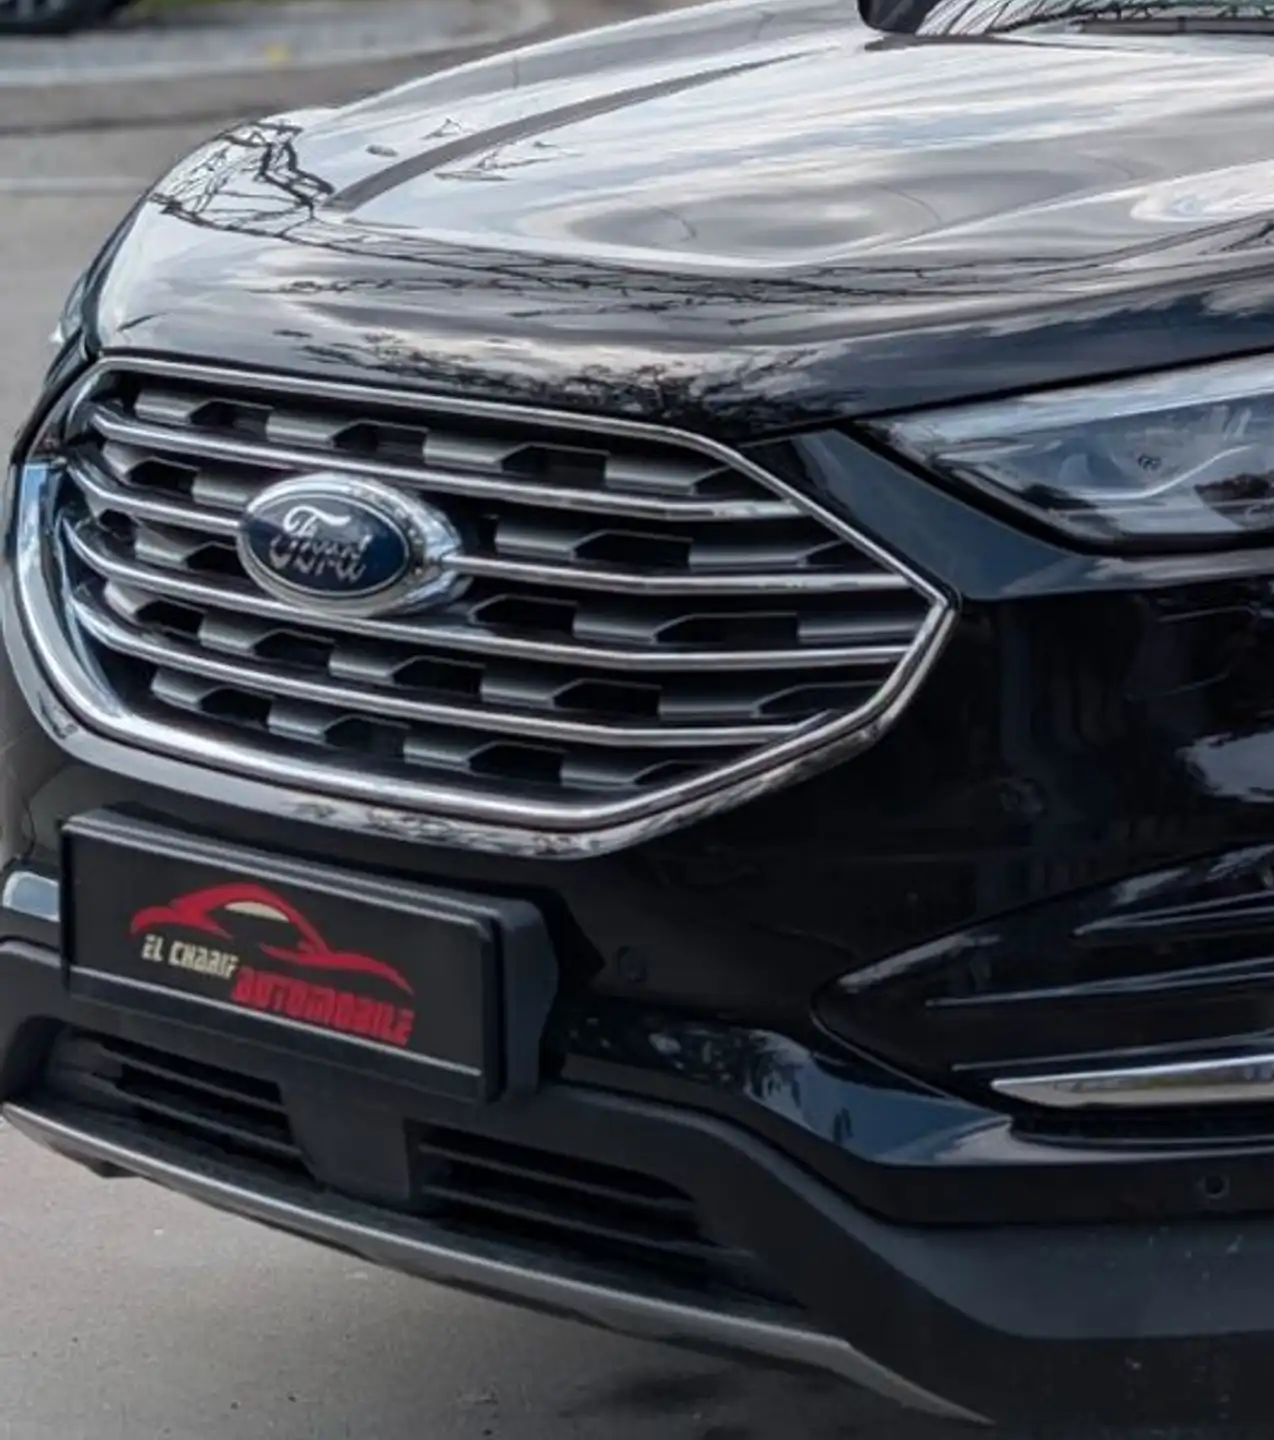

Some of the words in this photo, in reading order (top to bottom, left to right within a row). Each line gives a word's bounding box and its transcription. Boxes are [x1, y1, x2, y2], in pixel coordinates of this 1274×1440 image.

[269, 506, 373, 581] Ford
[141, 933, 164, 962] EL
[231, 966, 415, 1047] AUTOMOBILE
